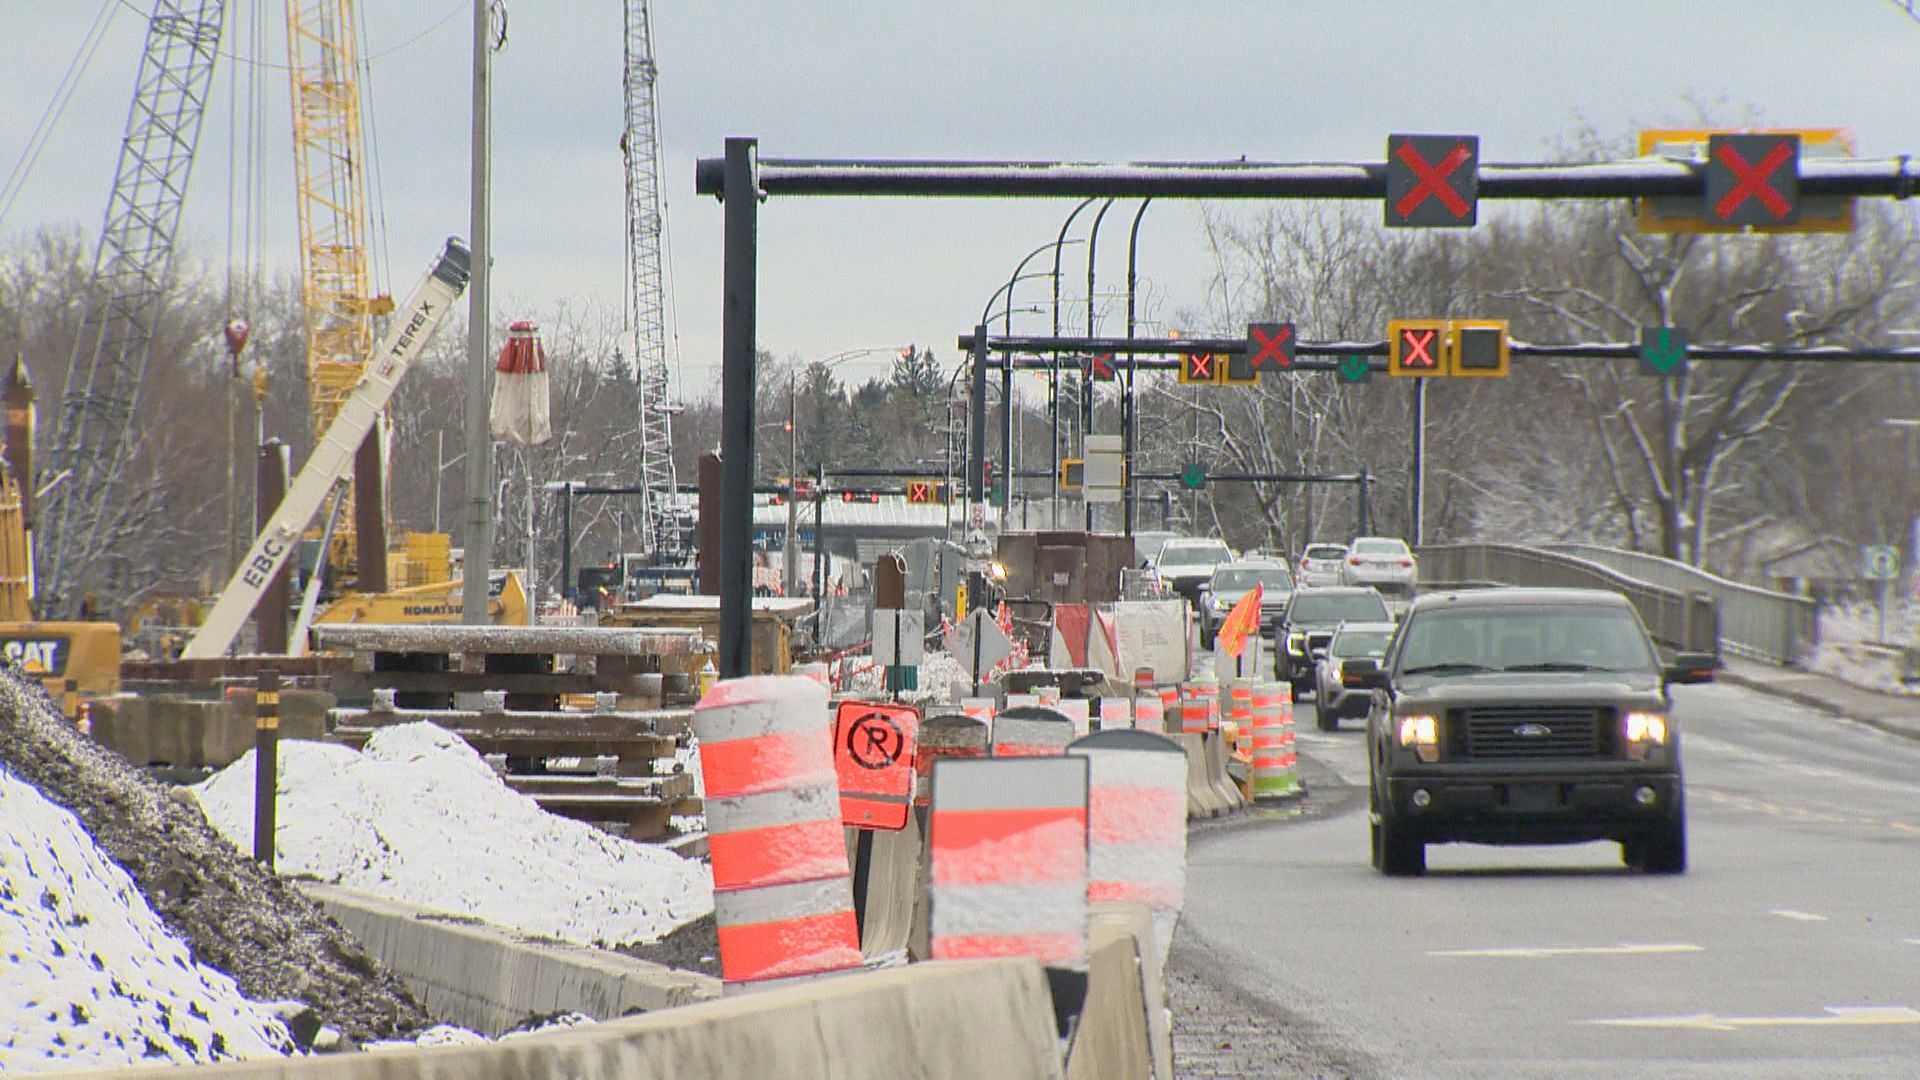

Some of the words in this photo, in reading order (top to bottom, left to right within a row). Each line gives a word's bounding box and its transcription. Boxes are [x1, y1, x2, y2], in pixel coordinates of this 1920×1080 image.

[391, 301, 434, 356] TEREX
[243, 539, 283, 588] EBC
[4, 641, 57, 673] CAT
